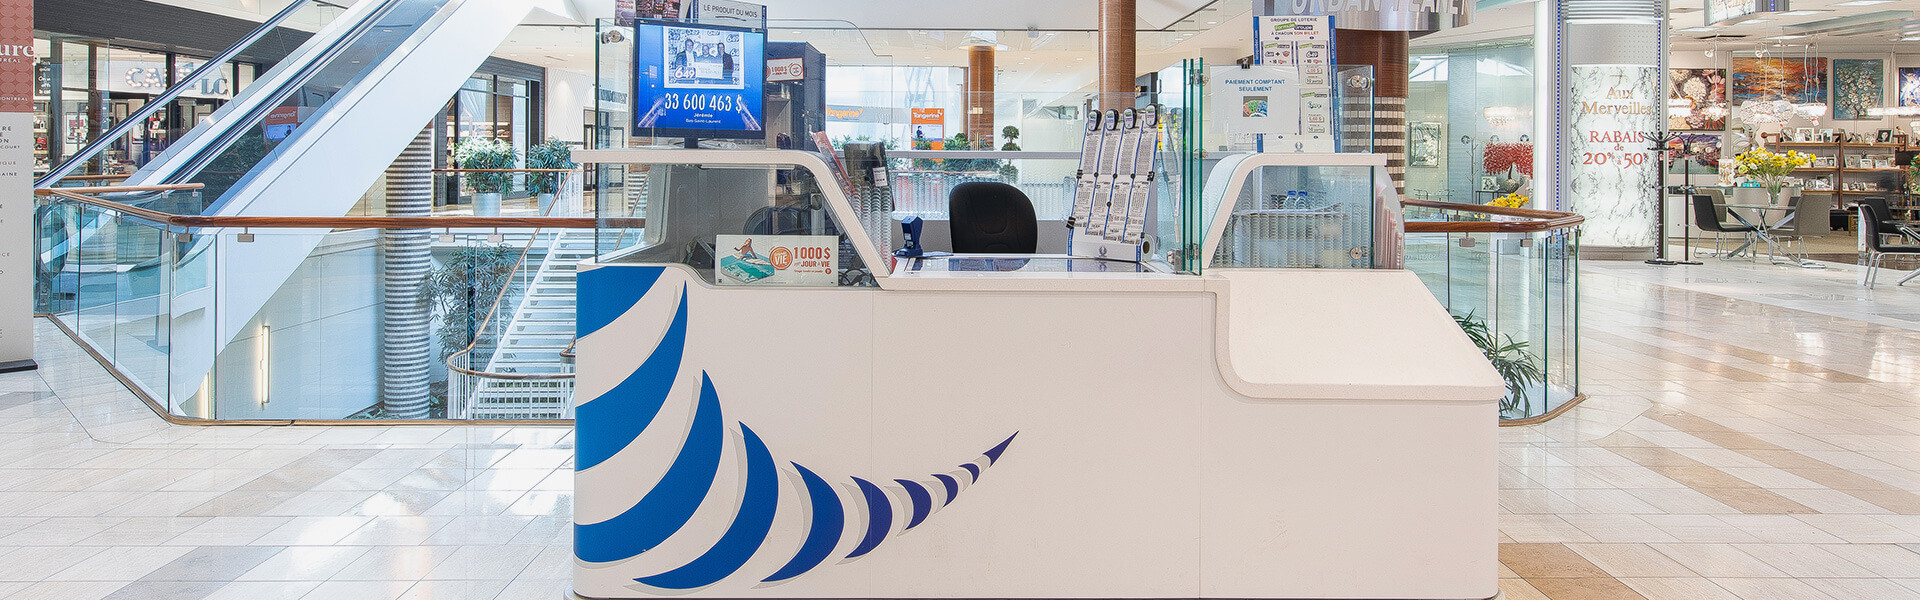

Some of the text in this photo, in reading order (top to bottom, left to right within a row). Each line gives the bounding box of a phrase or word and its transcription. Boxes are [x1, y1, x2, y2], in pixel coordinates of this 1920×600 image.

[703, 4, 758, 18] LE PRODUIT DU MOIS
[1605, 87, 1634, 99] Aux
[664, 92, 742, 114] 33 600 463 $
[1581, 101, 1651, 115] Merveilles
[825, 107, 860, 119] Tangerine
[912, 111, 940, 120] Tangerine
[1589, 131, 1645, 143] RABAIS
[1614, 143, 1624, 151] de
[801, 260, 817, 268] JOUR
[821, 260, 831, 268] VIE
